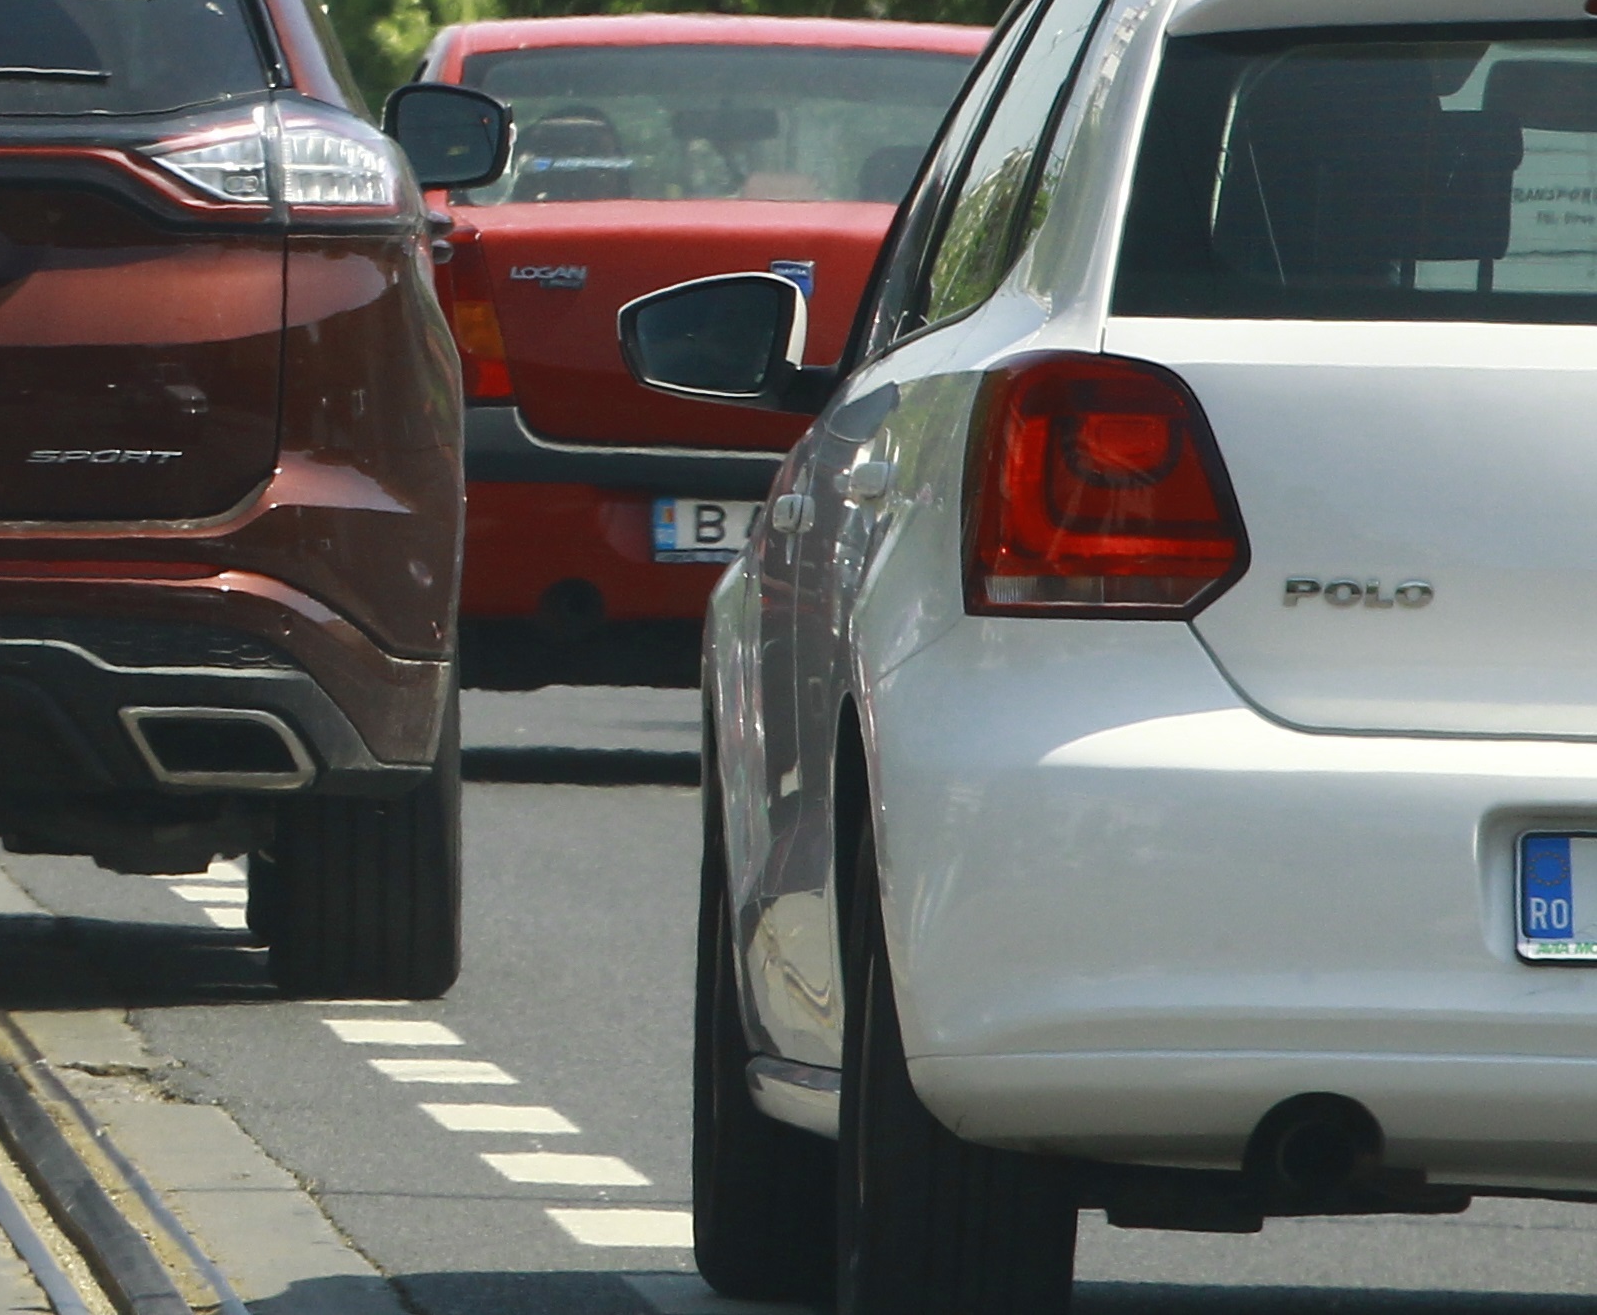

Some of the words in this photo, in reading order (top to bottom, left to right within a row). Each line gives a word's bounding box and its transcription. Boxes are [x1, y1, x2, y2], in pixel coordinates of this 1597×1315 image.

[510, 265, 588, 280] LOGAN
[26, 449, 183, 464] SPORT
[696, 504, 726, 543] B
[1282, 576, 1435, 609] POLO
[1530, 897, 1569, 930] RO
